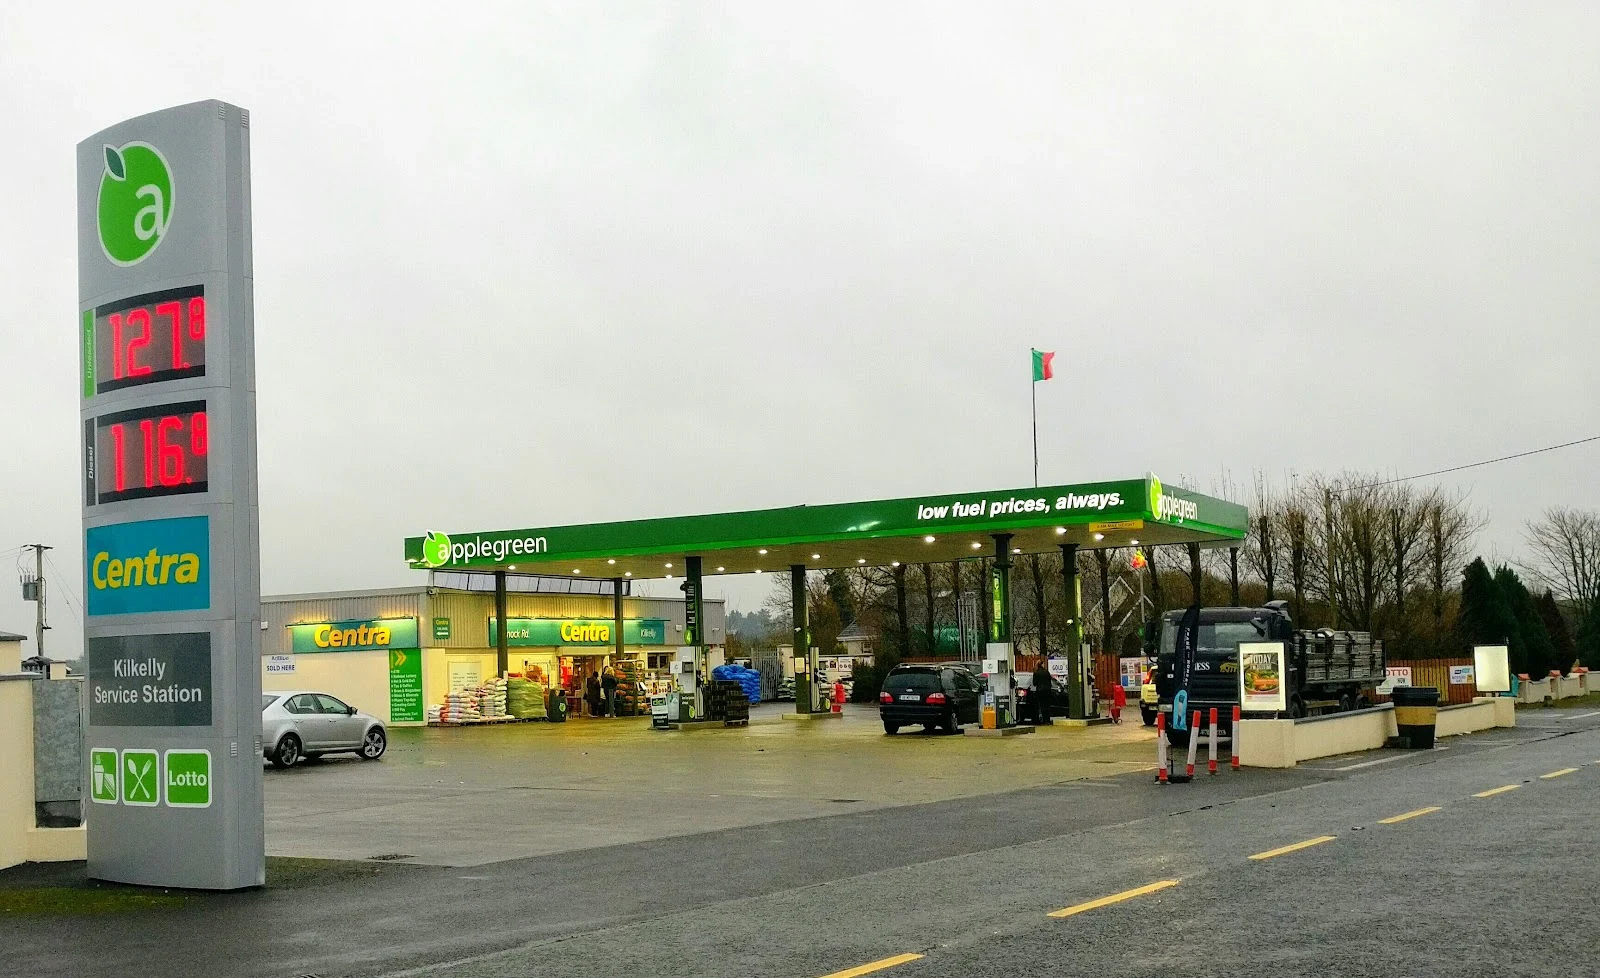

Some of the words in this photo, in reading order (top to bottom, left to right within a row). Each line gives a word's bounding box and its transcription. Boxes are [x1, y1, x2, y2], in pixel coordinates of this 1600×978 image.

[918, 505, 947, 520] low
[952, 500, 985, 517] fuel
[990, 497, 1049, 516] prices,
[1055, 493, 1124, 510] always.
[1157, 490, 1198, 524] applegreen
[438, 536, 548, 563] applegreen
[91, 547, 200, 589] Centra
[314, 624, 391, 648] Centra
[507, 629, 520, 638] nock
[561, 621, 610, 642] Centra
[114, 658, 166, 681] Kilkelly
[1250, 654, 1271, 664] TODAY
[95, 685, 138, 704] Service
[142, 684, 202, 703] Station
[168, 769, 208, 786] Lotto
